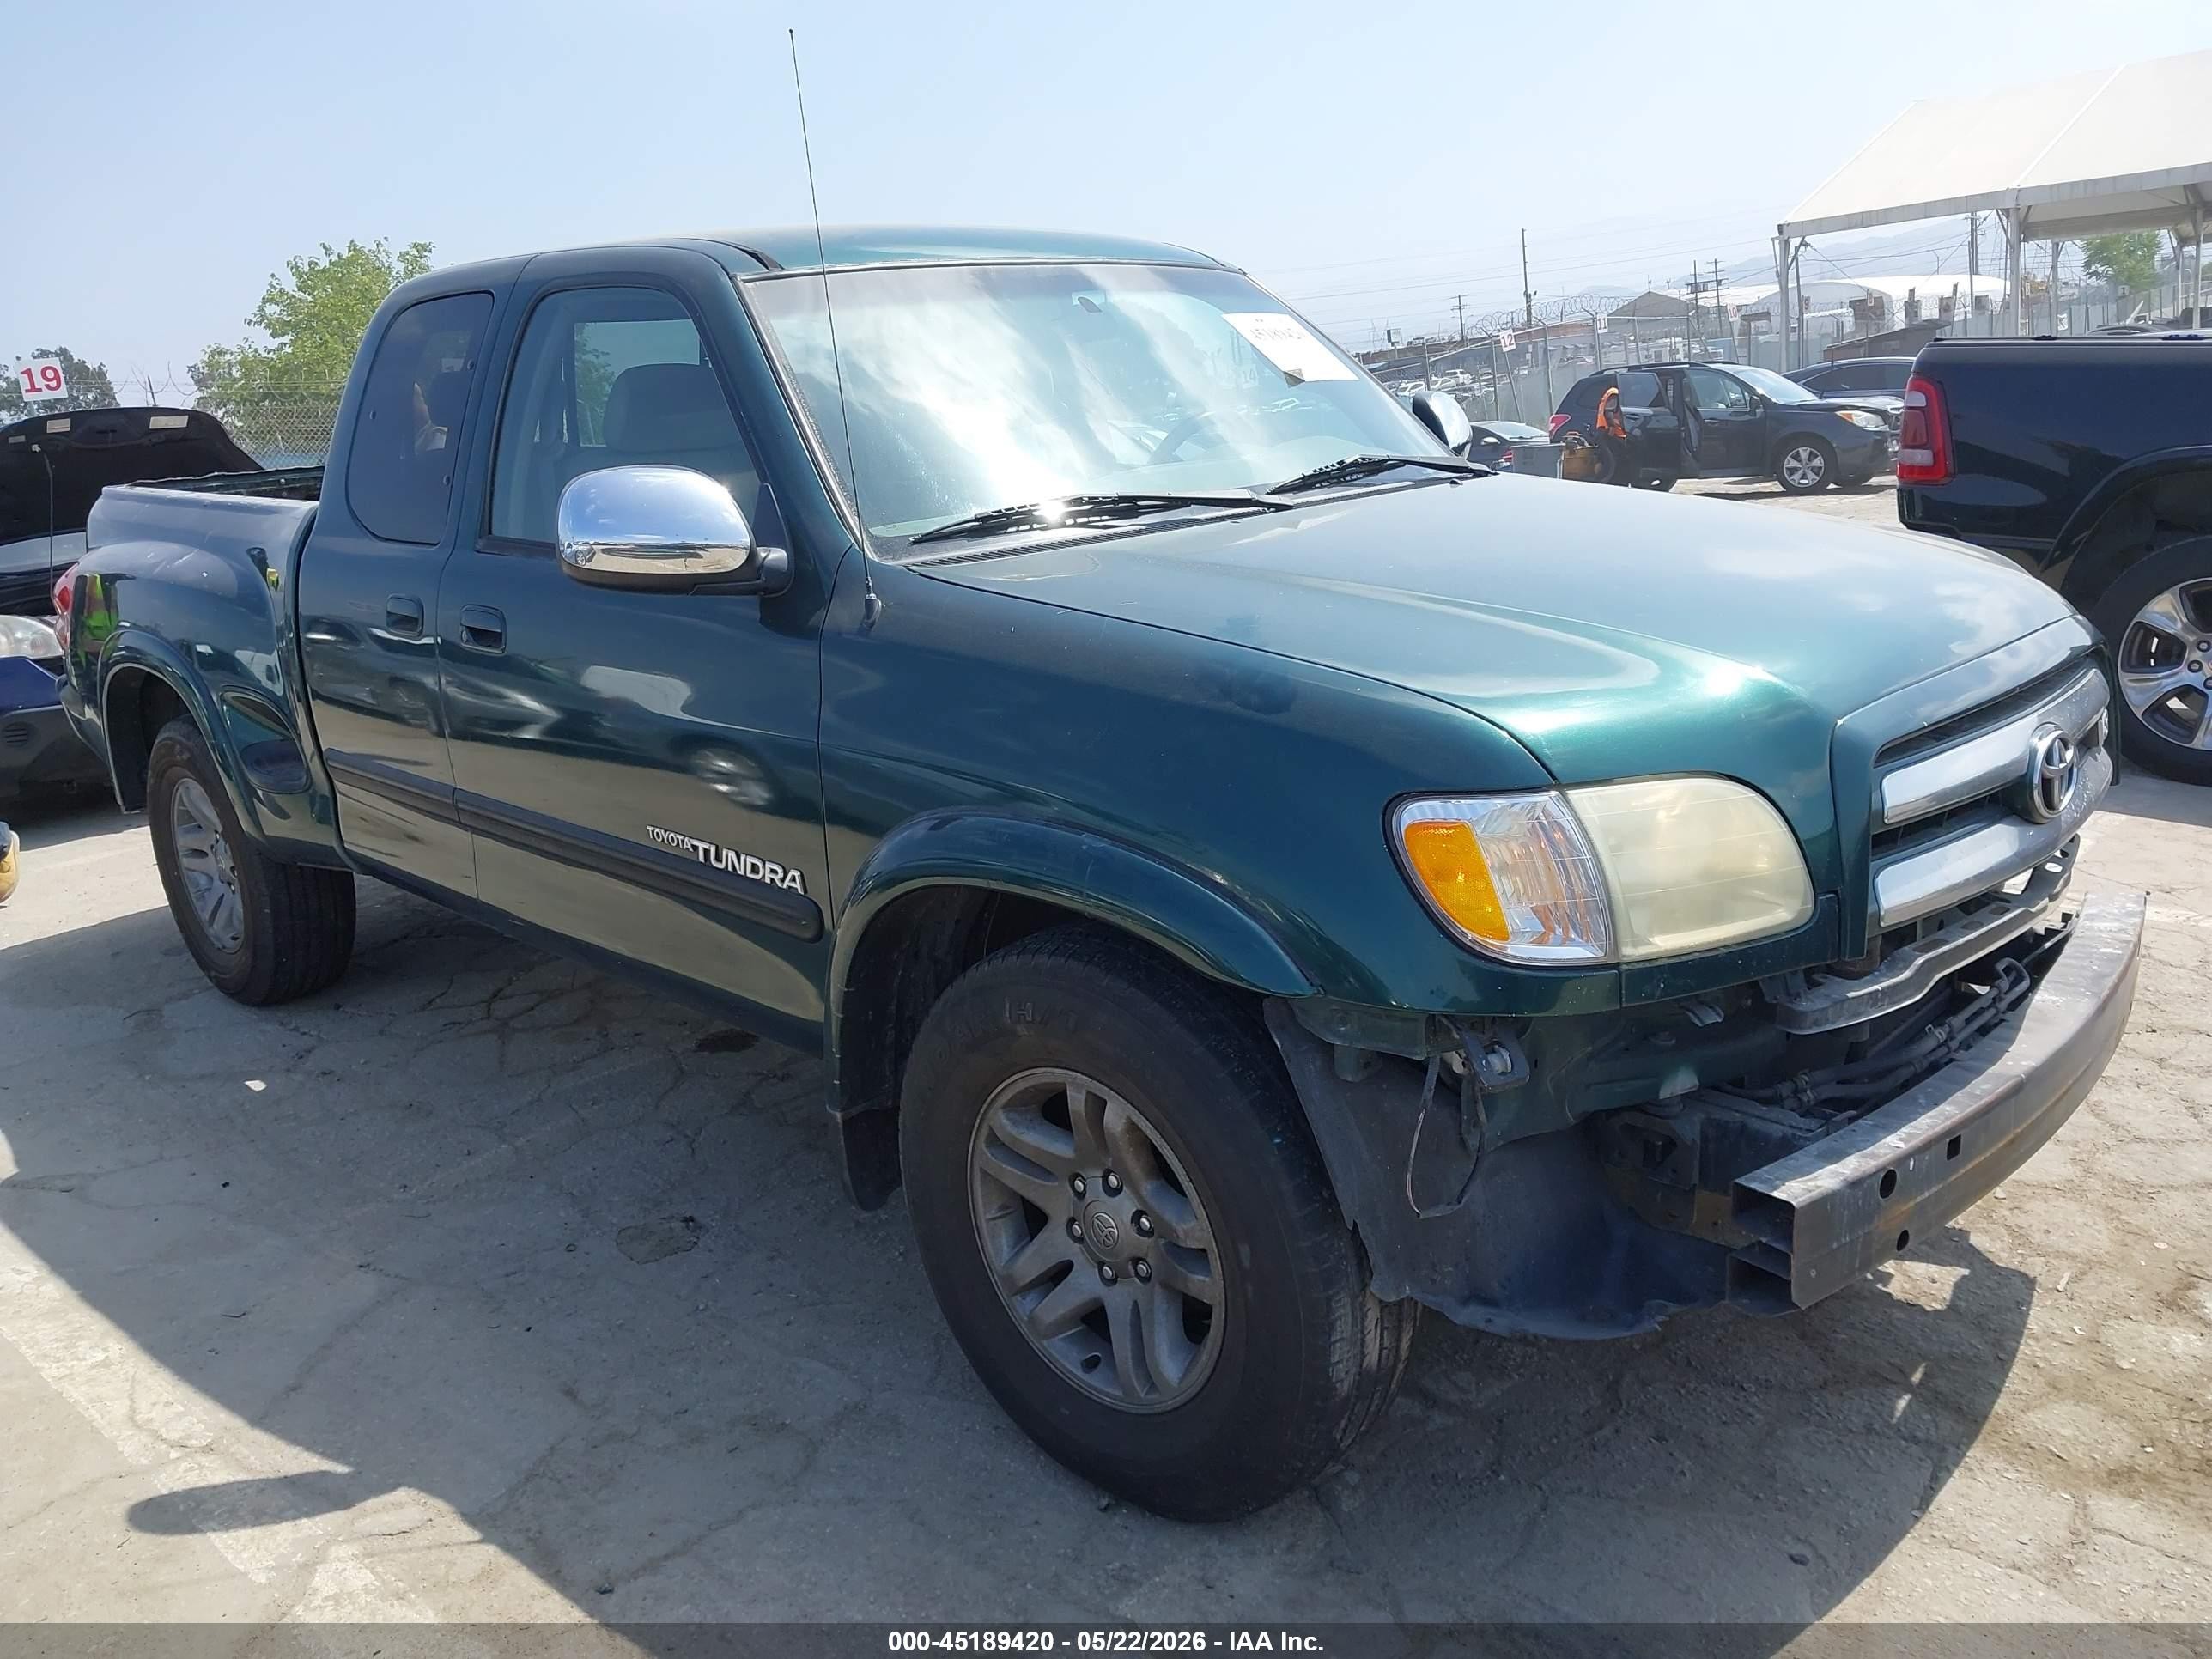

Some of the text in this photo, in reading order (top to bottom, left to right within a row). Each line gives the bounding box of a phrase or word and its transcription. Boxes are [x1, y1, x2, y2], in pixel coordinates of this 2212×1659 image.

[1597, 312, 1607, 331] 11
[1728, 307, 1738, 319] 10
[1501, 333, 1515, 349] 12
[20, 365, 62, 393] 19
[647, 825, 805, 895] TOYOTA TUNDRA
